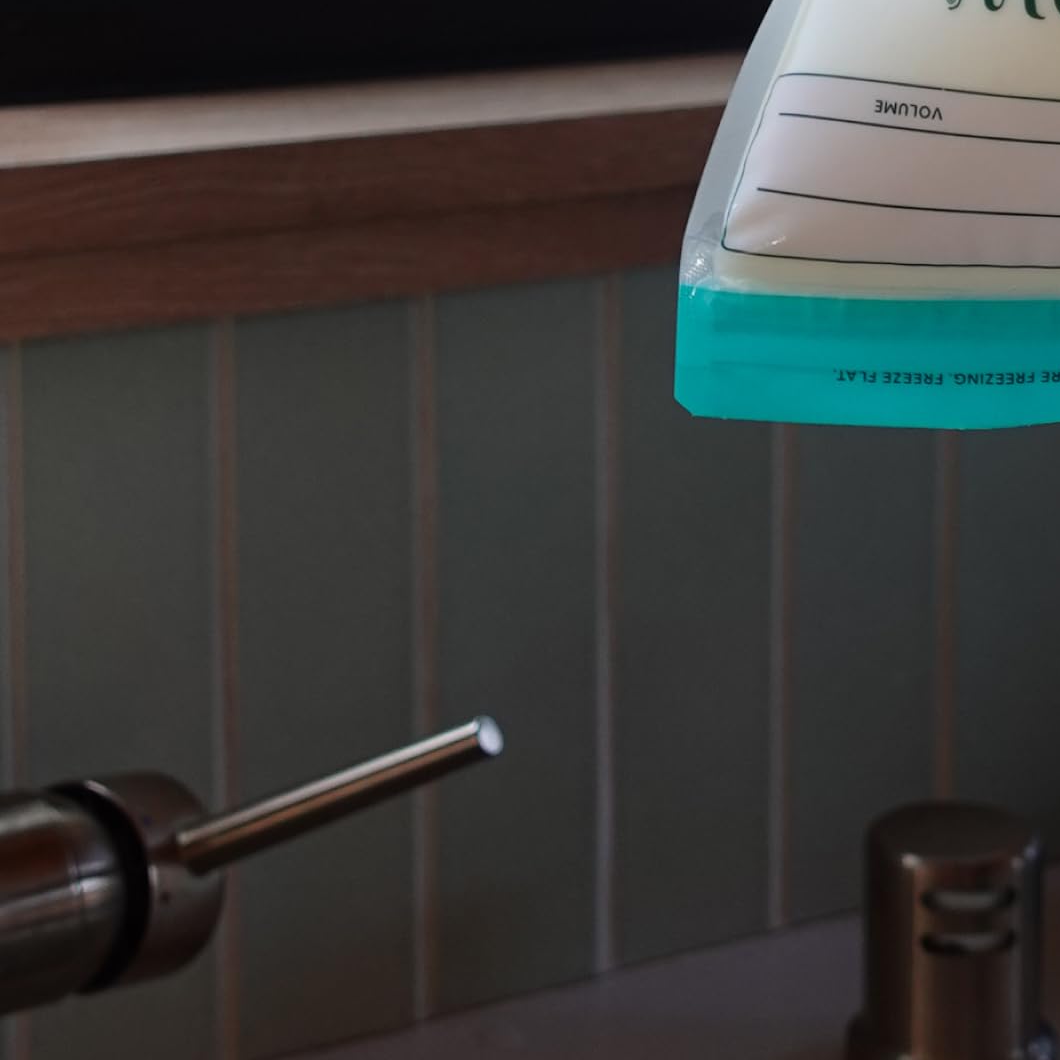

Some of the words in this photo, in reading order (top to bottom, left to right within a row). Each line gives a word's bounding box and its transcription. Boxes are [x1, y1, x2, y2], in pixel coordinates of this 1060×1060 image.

[874, 99, 943, 121] VOLUME
[833, 369, 877, 383] FLAT.
[882, 371, 943, 386] FREEZE
[949, 371, 1036, 386] FREEZING.
